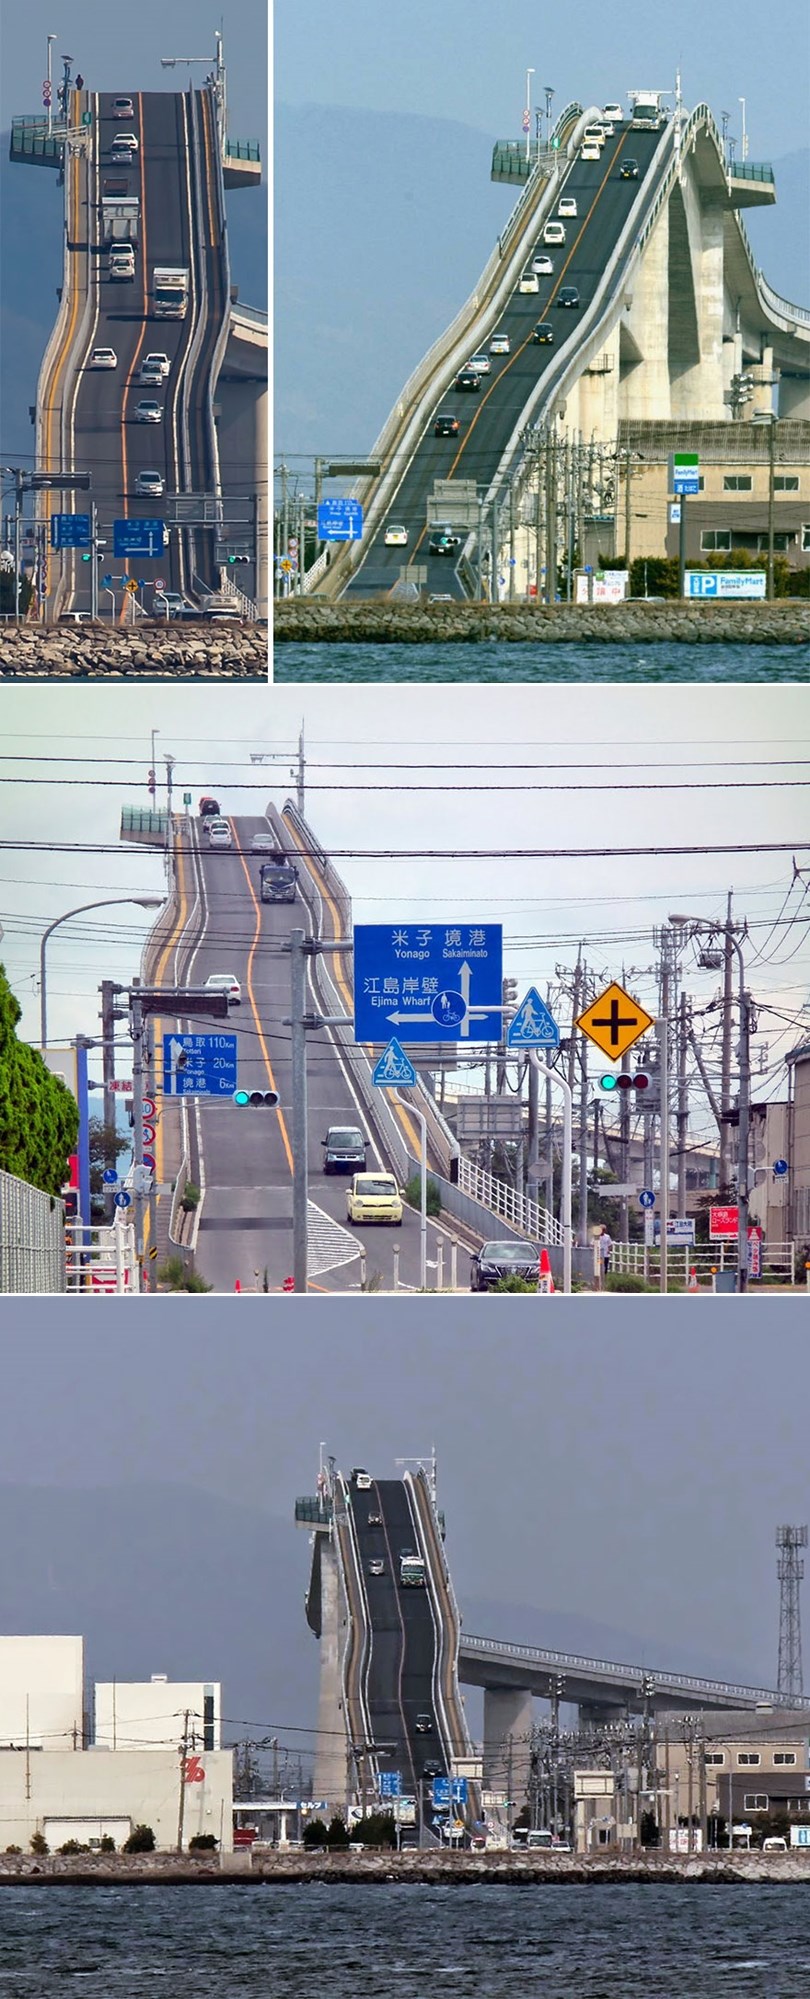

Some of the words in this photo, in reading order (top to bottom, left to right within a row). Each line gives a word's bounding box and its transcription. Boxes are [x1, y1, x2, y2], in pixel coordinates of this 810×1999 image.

[701, 576, 715, 593] P
[720, 576, 763, 587] FamilyMart
[391, 929, 433, 947] 米子
[444, 929, 487, 947] 境港
[395, 949, 430, 960] Yonago
[442, 949, 488, 959] Sakaiminato
[363, 976, 439, 995] 江島岸壁
[371, 996, 398, 1007] Ejima
[402, 996, 431, 1006] Wharf
[183, 1036, 206, 1048] 鳥取
[183, 1077, 207, 1089] 境港
[300, 1801, 321, 1809] セルフ
